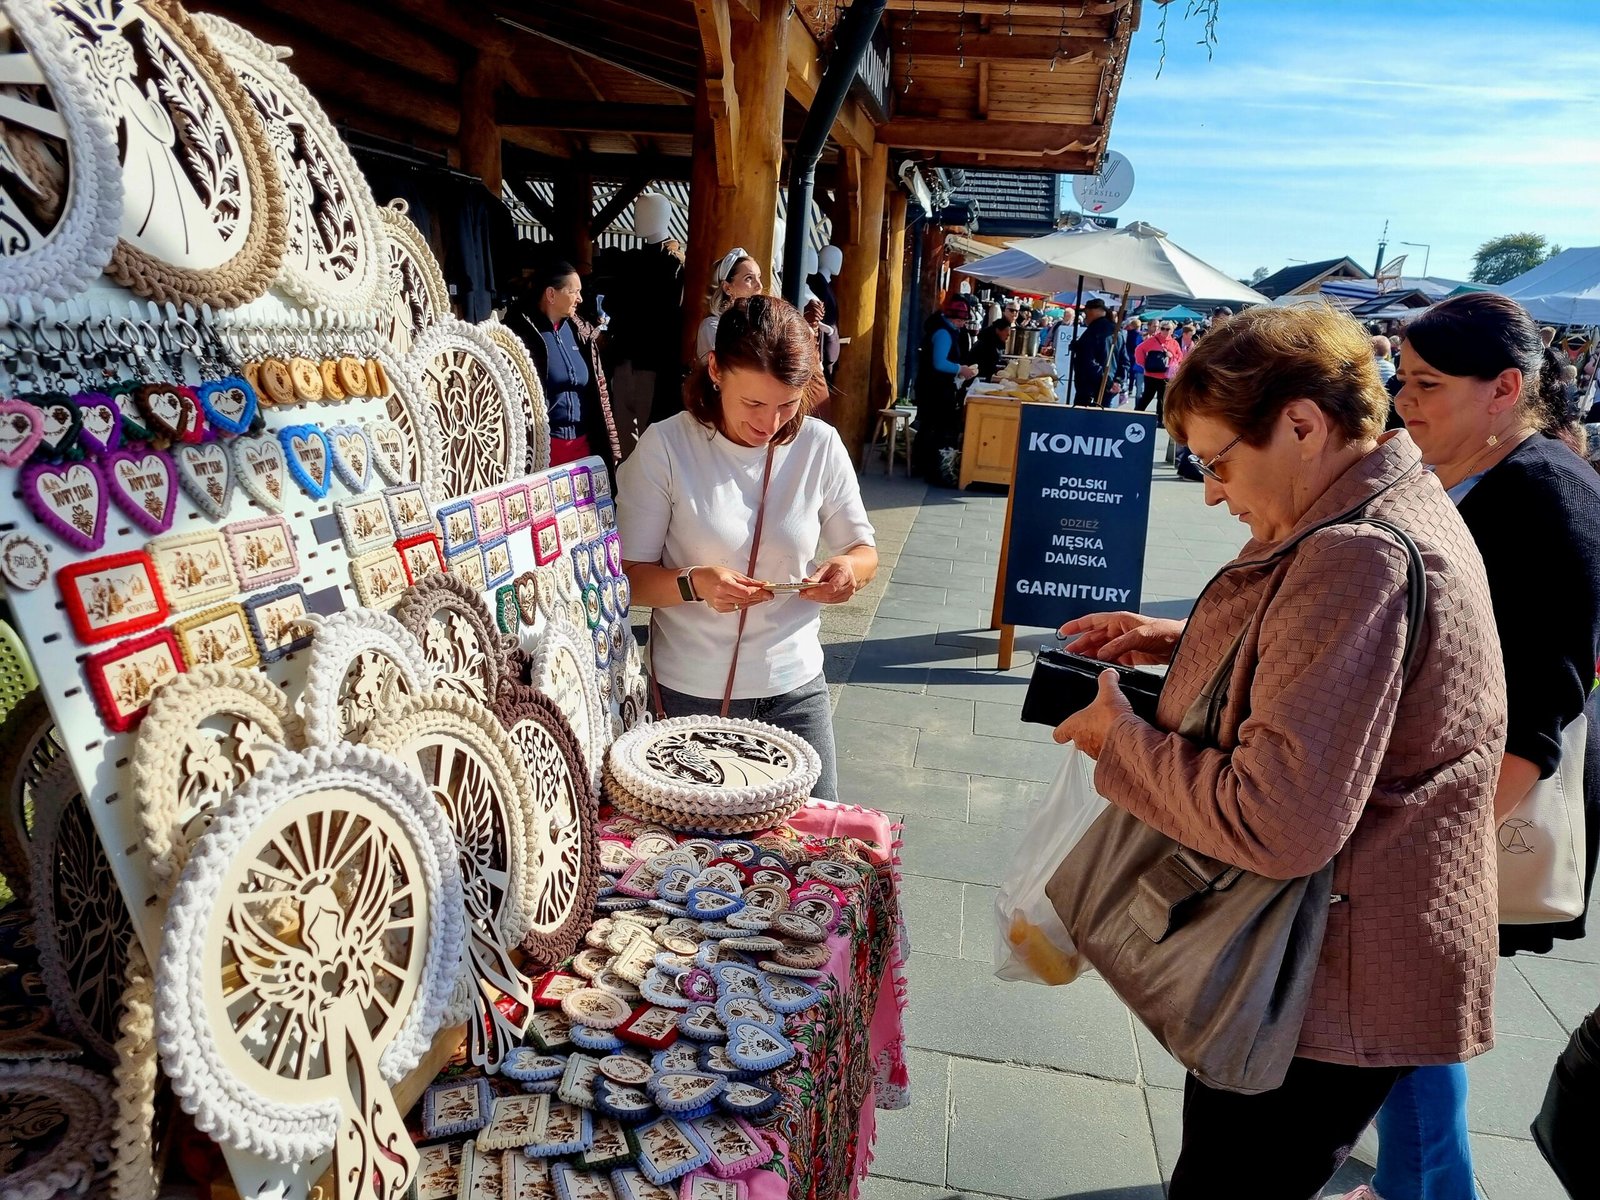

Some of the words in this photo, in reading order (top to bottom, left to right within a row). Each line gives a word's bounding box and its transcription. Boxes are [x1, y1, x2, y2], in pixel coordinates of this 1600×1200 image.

[1028, 431, 1125, 459] KONIK
[1059, 476, 1107, 490] POLSKI
[1041, 487, 1123, 505] PRODUCENT
[1060, 517, 1099, 530] ODZIEŻ
[1052, 534, 1104, 551] MĘSKA
[1044, 551, 1107, 569] DAMSKA
[1016, 579, 1131, 603] GARNITURY
